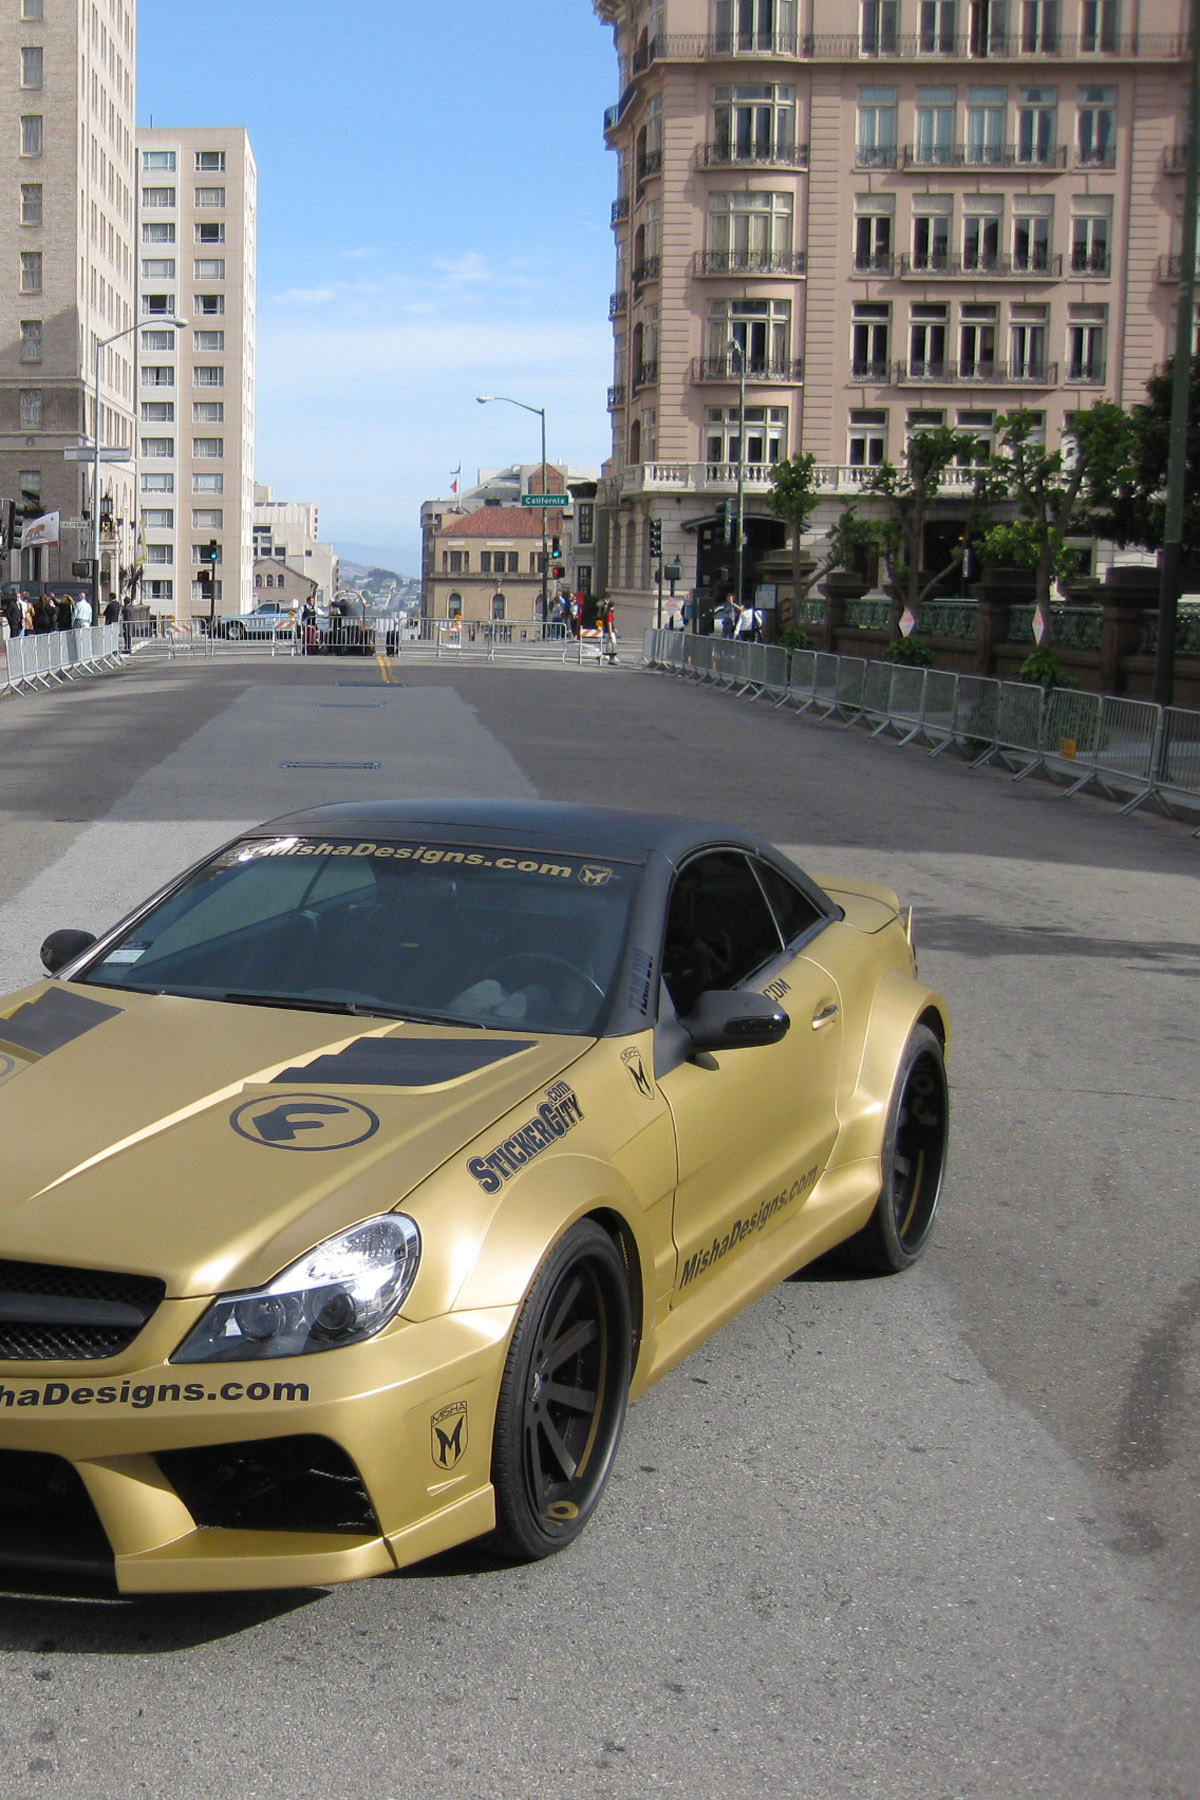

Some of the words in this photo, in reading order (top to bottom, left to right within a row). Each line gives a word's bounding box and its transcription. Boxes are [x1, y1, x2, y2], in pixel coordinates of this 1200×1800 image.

[525, 497, 565, 505] California
[263, 842, 572, 878] MishaDesigns.com
[679, 1165, 818, 1291] MishaDesigns.com
